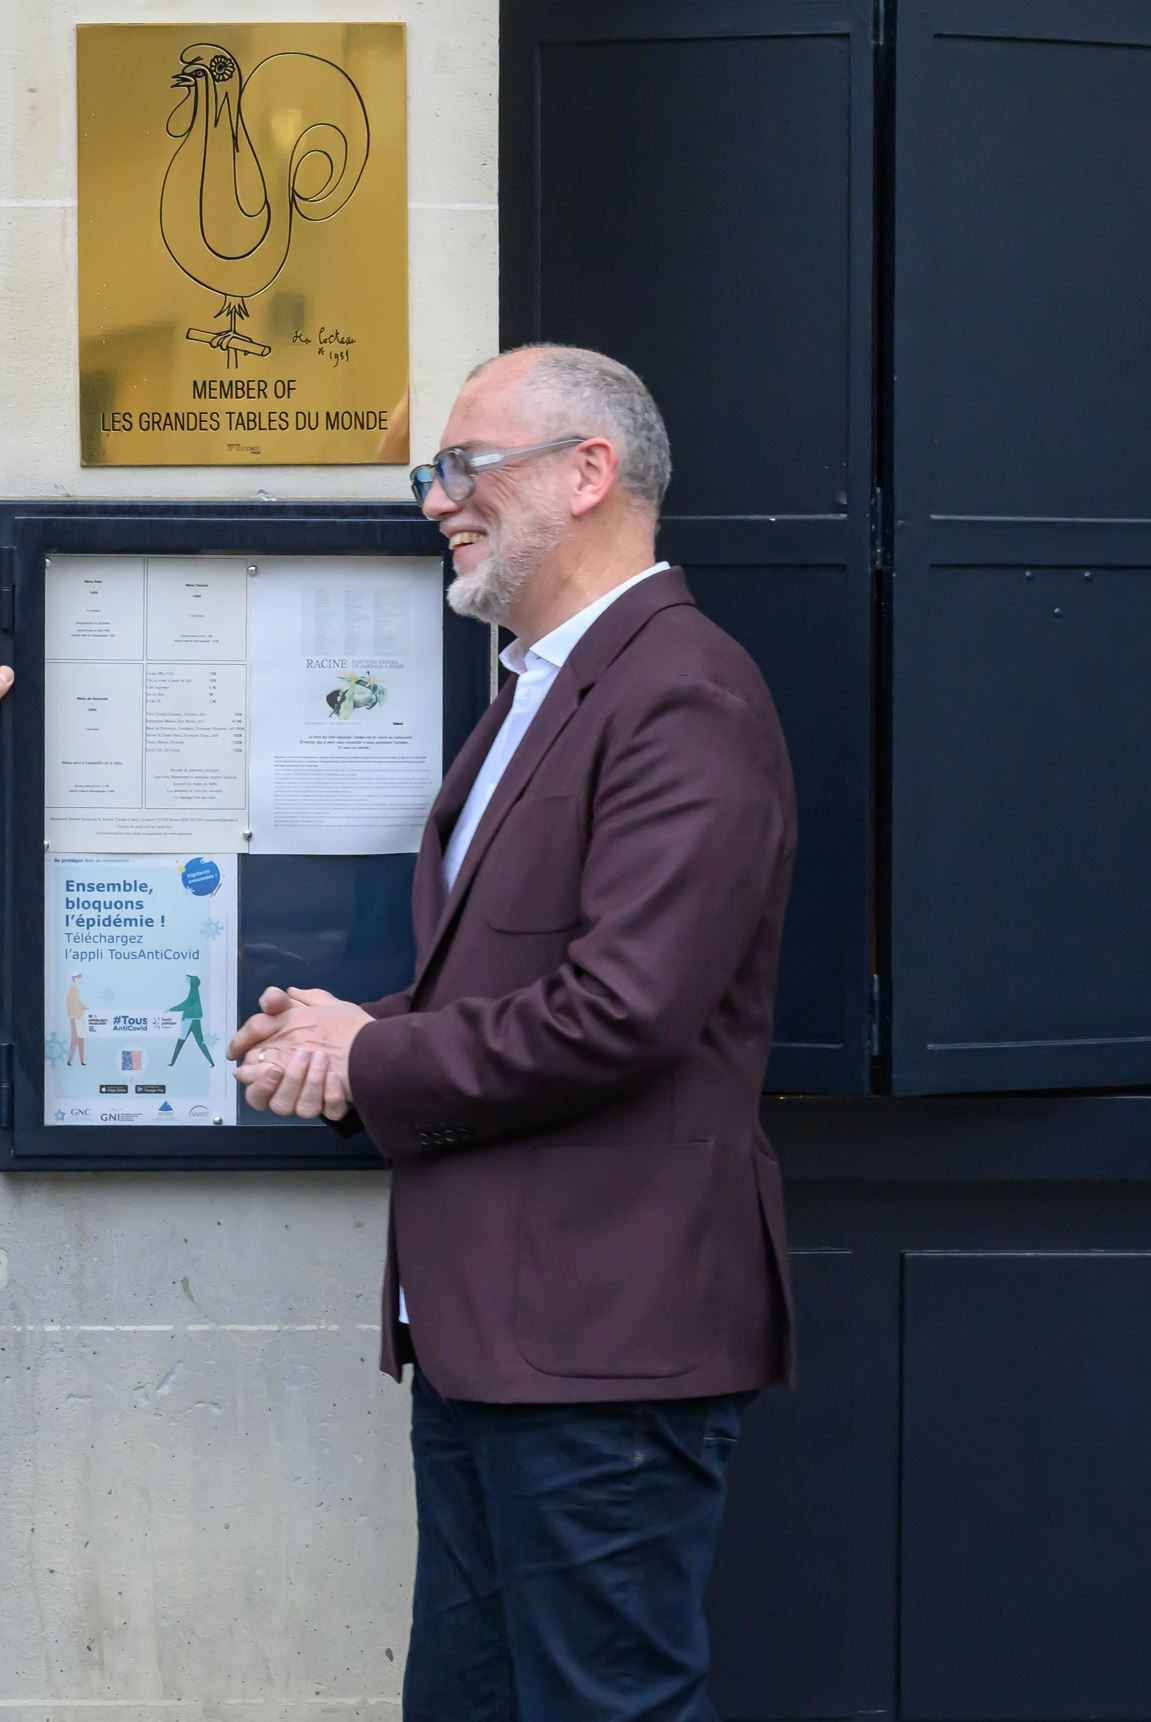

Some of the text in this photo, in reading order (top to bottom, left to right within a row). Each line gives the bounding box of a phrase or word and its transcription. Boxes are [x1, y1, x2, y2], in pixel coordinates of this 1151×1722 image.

[192, 379, 297, 400] MEMBER OF
[101, 410, 388, 432] LES GRANDES TABLES DU MONDE
[305, 658, 348, 669] RACINE
[65, 880, 154, 895] Ensemble,
[65, 897, 144, 912] bloquons
[160, 915, 165, 928] !
[64, 932, 144, 946] Téléchargez
[108, 949, 200, 960] TousAntiCovid
[113, 1016, 148, 1025] #Tous
[70, 1108, 91, 1117] GNC
[100, 1113, 120, 1122] GNI
